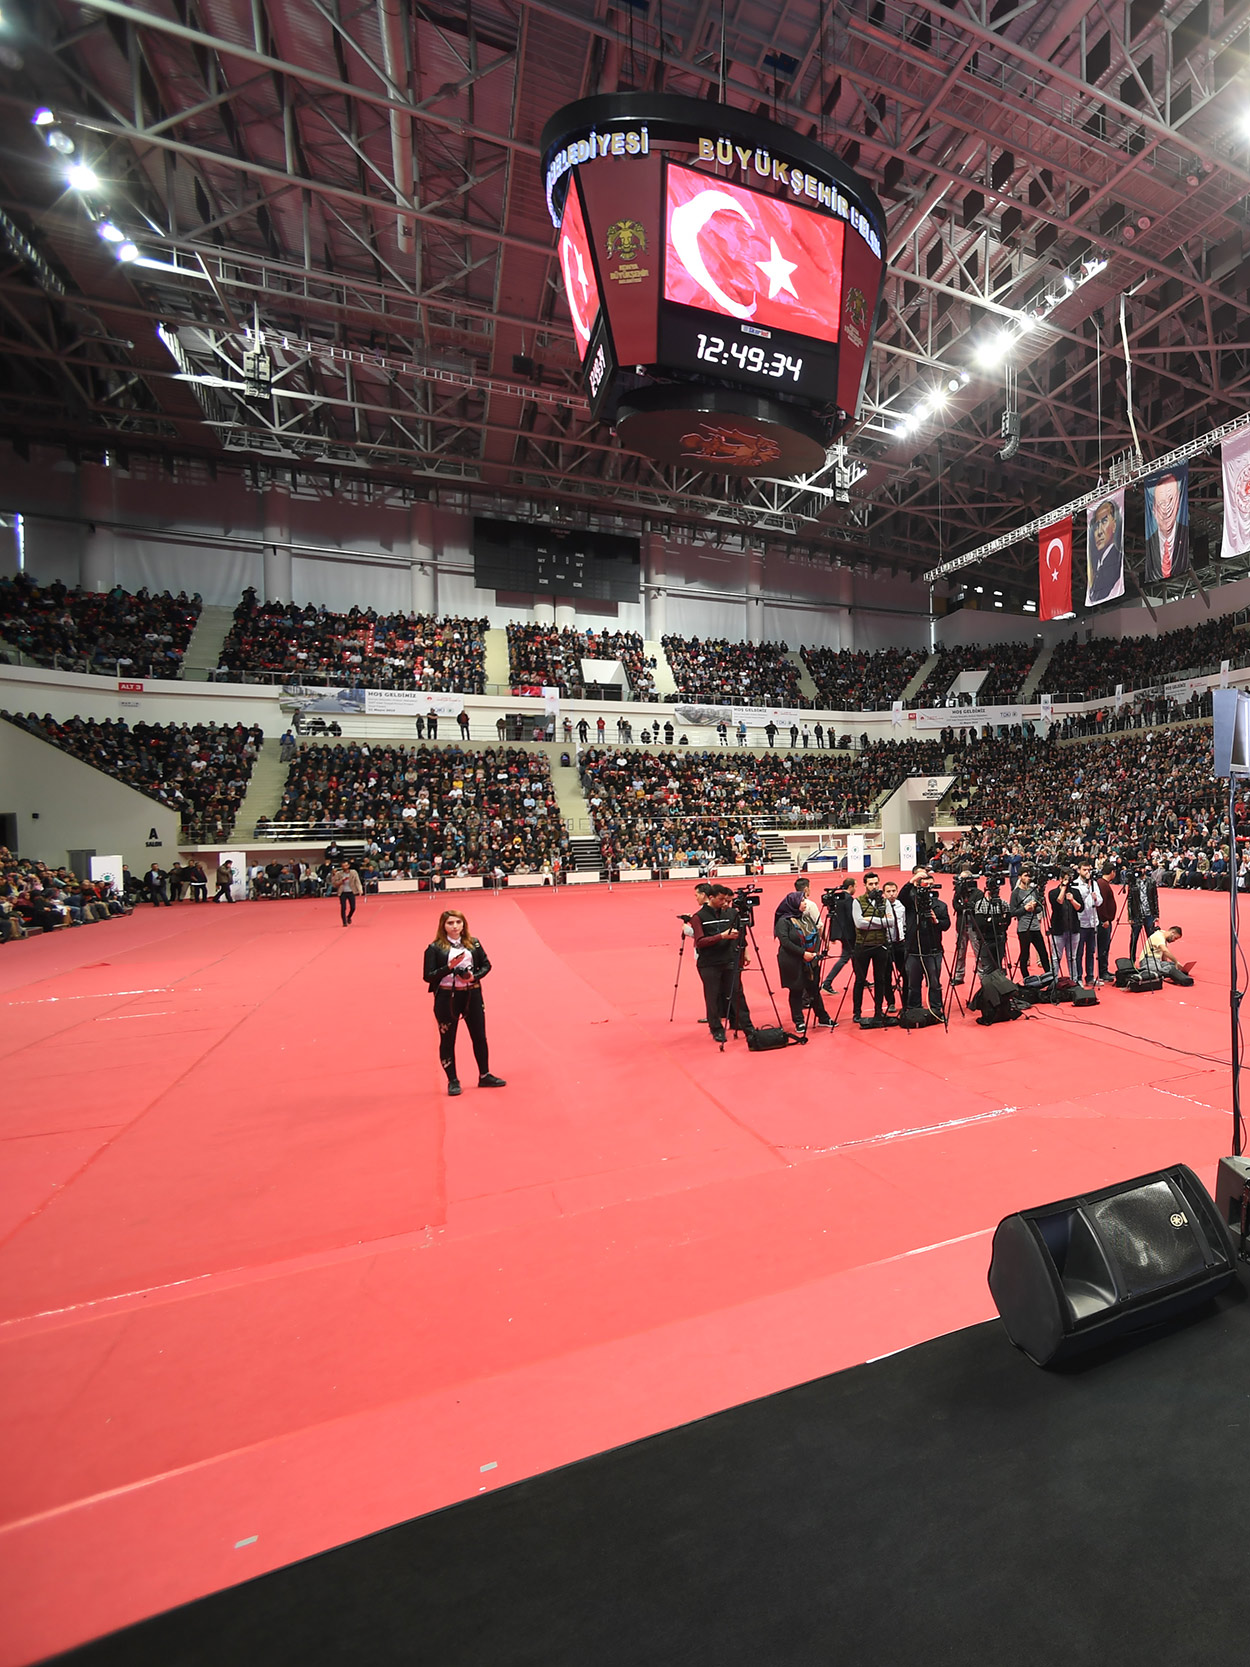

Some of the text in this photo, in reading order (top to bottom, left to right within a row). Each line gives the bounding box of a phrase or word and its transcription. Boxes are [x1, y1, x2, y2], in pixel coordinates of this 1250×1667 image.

[698, 136, 850, 220] BÜYÜKŞEHİR
[696, 333, 803, 382] 12:49:34
[149, 828, 158, 839] A
